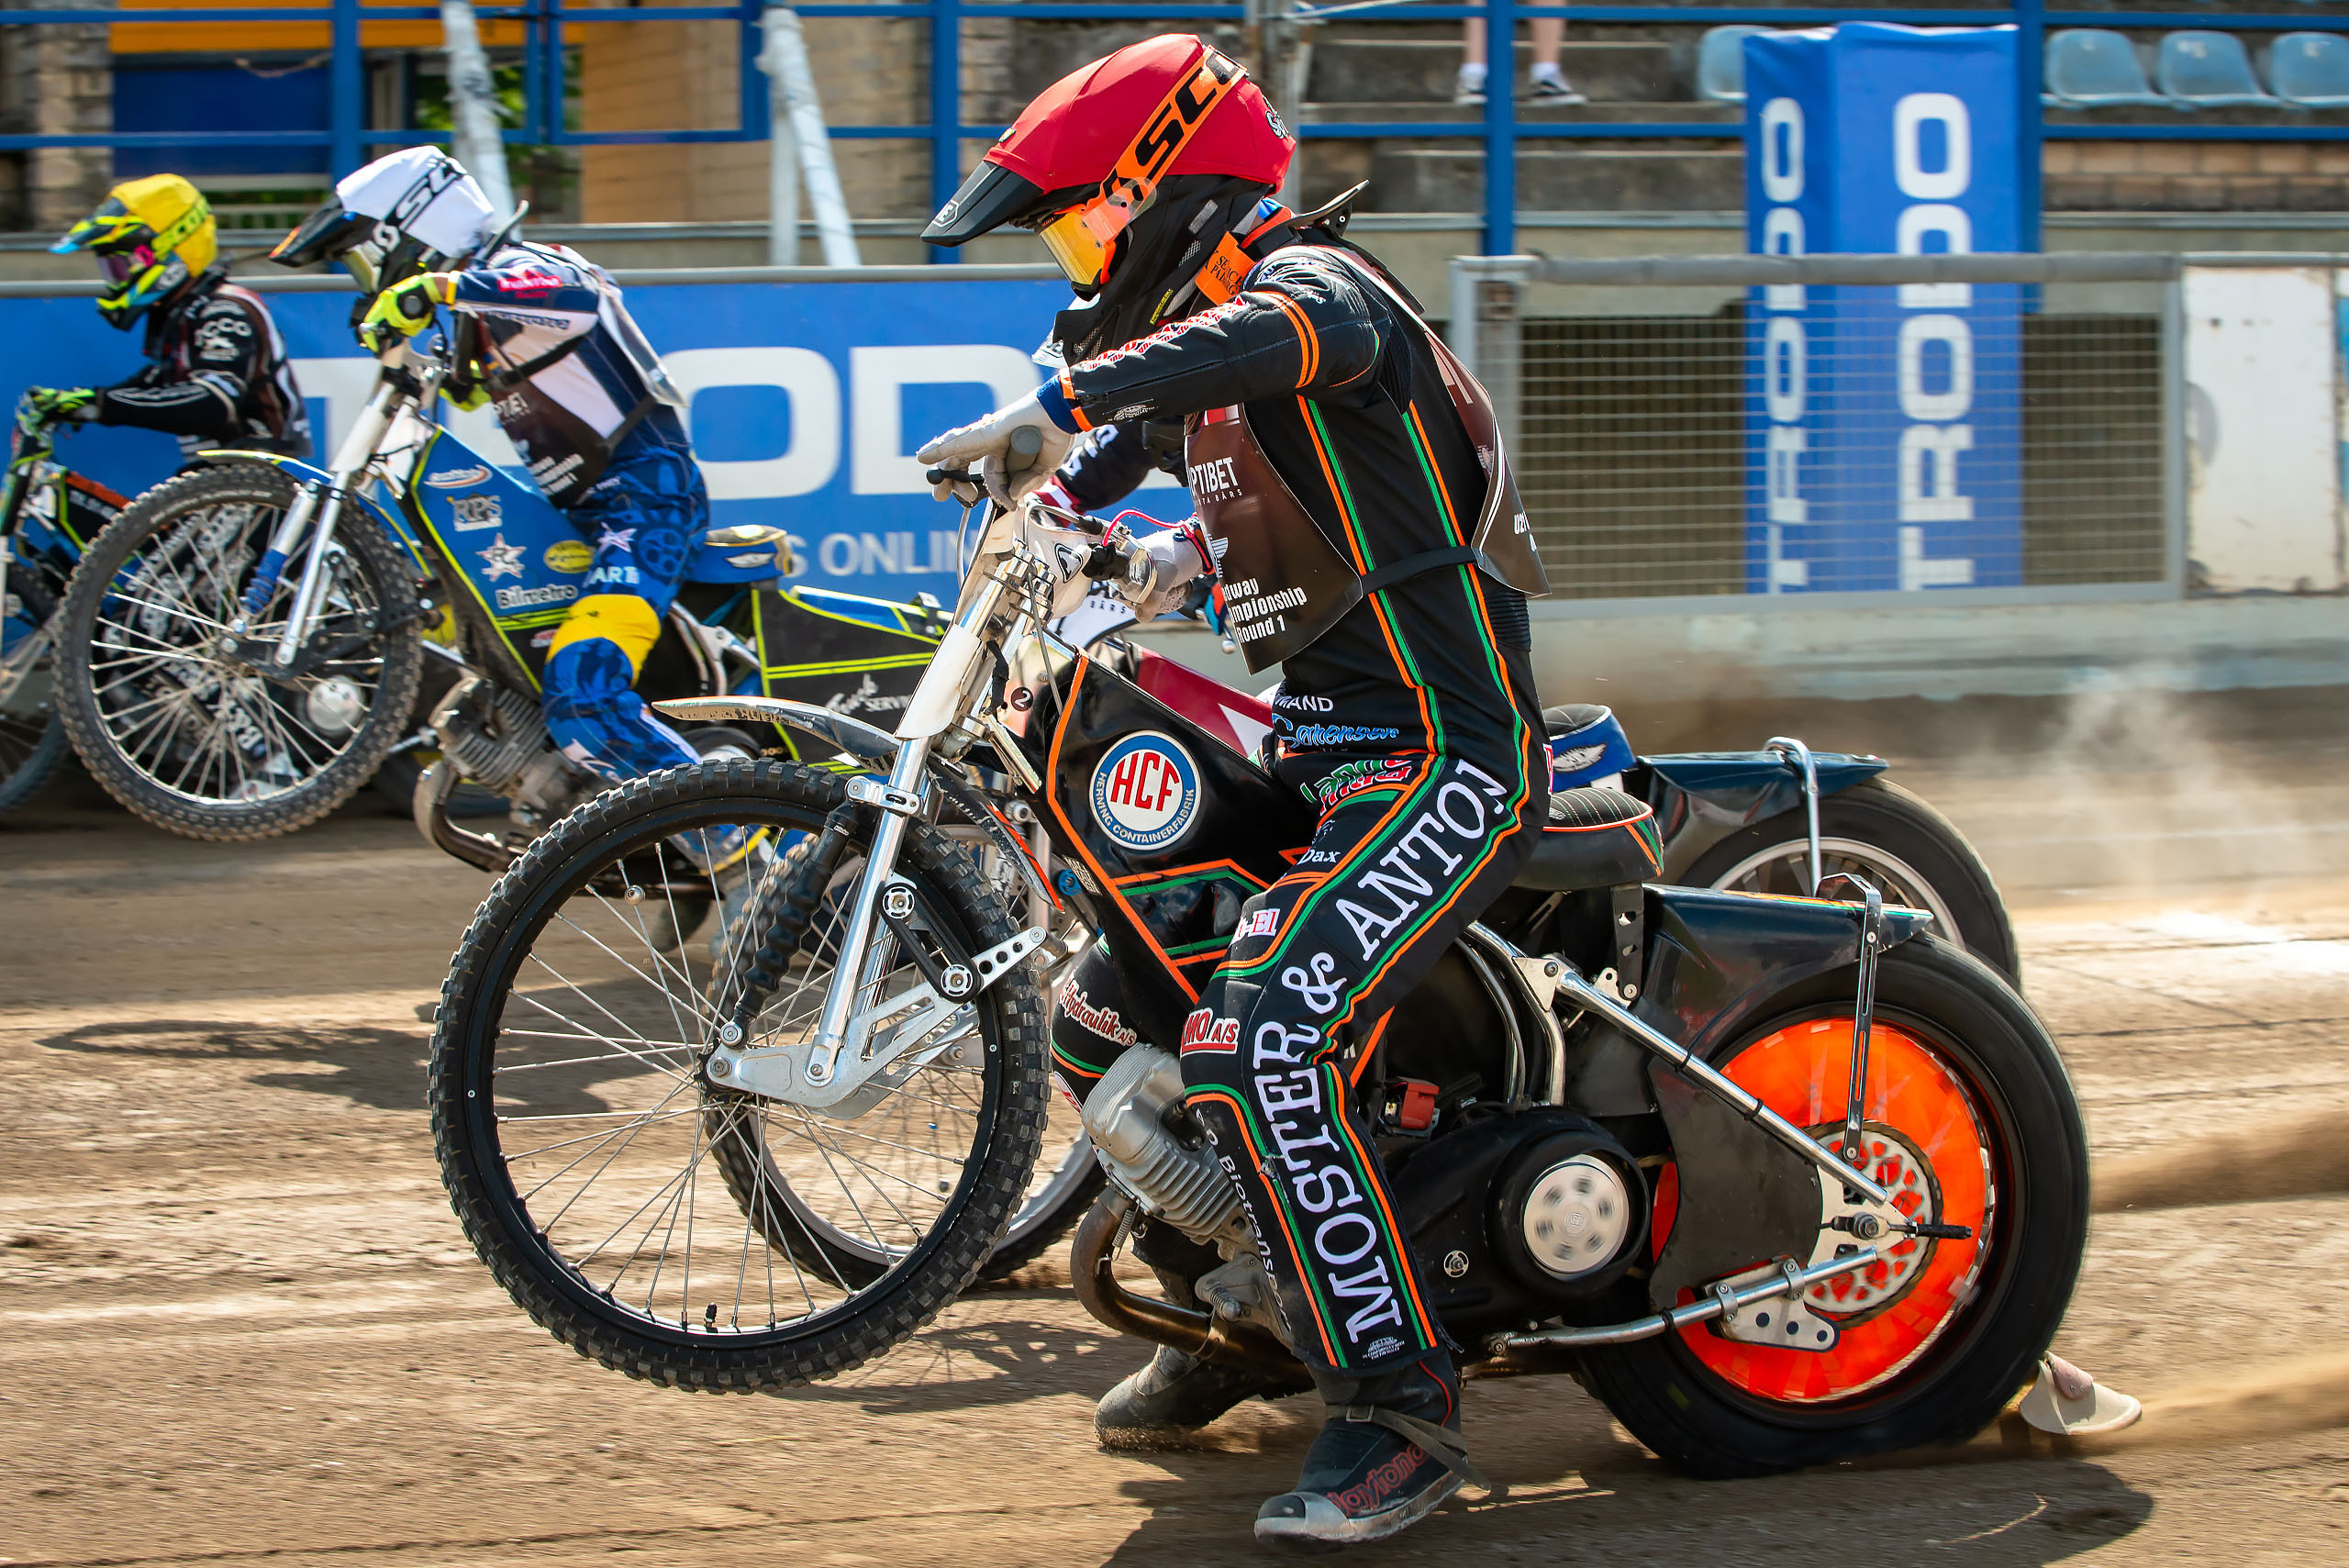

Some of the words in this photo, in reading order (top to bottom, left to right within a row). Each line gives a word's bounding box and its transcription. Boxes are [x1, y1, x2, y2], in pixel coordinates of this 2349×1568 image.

[1761, 96, 1809, 595] TRODO
[1893, 92, 1974, 593] TRODO
[1187, 456, 1239, 498] PTIBET
[1222, 577, 1260, 602] dway
[1229, 586, 1308, 623] mpionship
[1276, 614, 1286, 632] 1
[1014, 689, 1031, 708] 2
[1110, 751, 1180, 812] HCF
[1096, 772, 1114, 827] HERNING
[1112, 788, 1195, 844] CONTAINERFABRIK
[1281, 951, 1347, 1015] &
[1211, 1021, 1238, 1044] A/S
[1252, 1020, 1403, 1344] MOSTER
